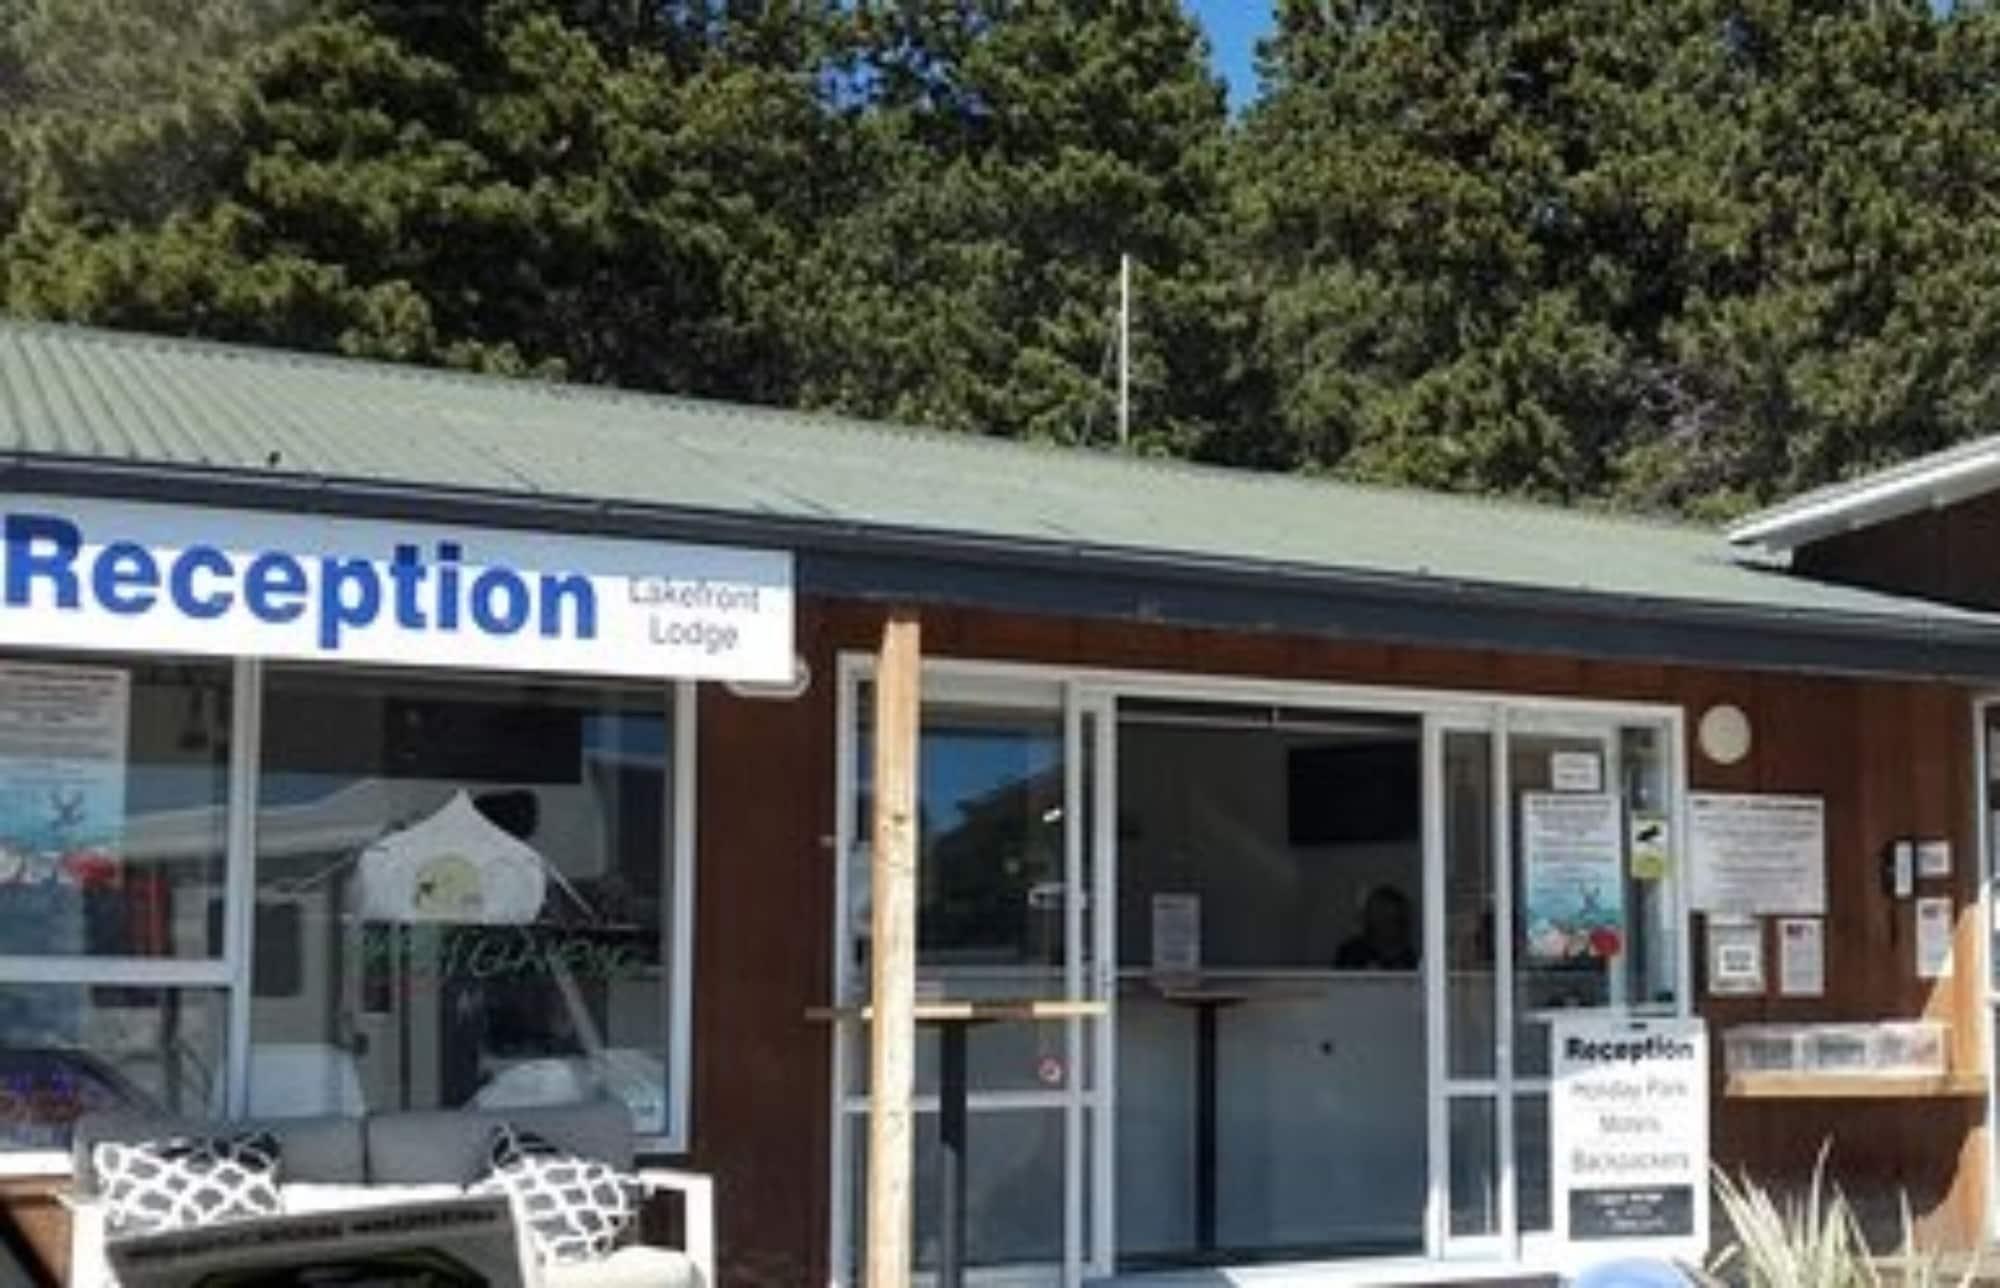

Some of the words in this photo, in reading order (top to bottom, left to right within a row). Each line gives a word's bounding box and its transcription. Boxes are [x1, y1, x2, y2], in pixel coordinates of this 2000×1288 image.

[3, 513, 597, 650] Reception
[628, 576, 760, 614] Lakefront
[650, 614, 739, 655] Lodge
[1565, 1034, 1695, 1065] Reception
[1645, 1076, 1690, 1098] Park
